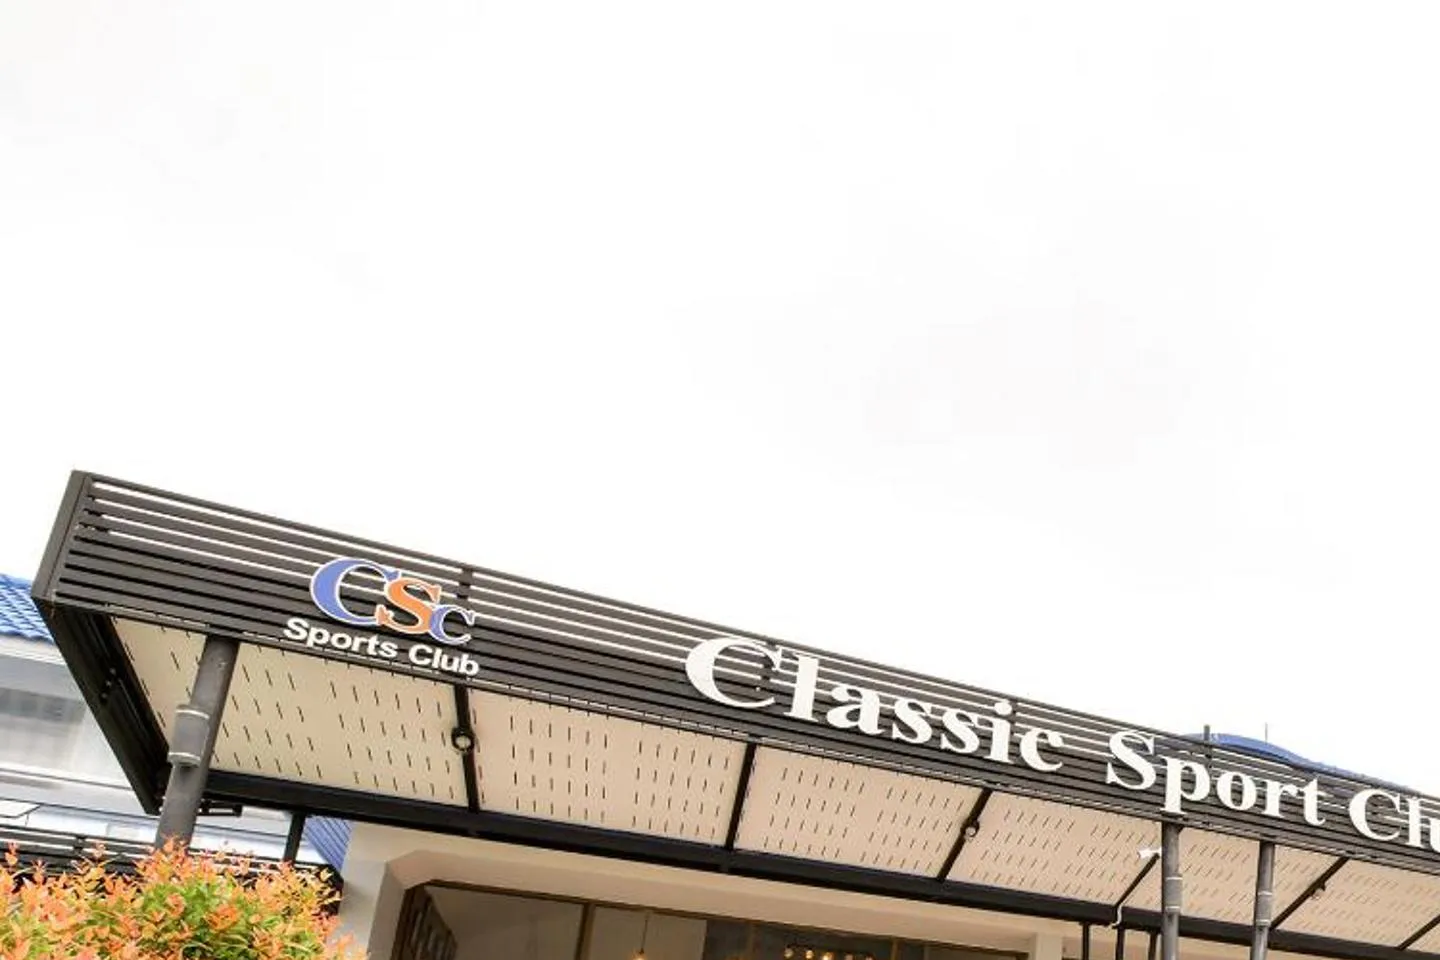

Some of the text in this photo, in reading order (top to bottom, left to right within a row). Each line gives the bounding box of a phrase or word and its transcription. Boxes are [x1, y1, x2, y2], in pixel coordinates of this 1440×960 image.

[283, 616, 480, 676] Sports Club
[685, 636, 1063, 773] Classic
[1105, 729, 1326, 826] Sport
